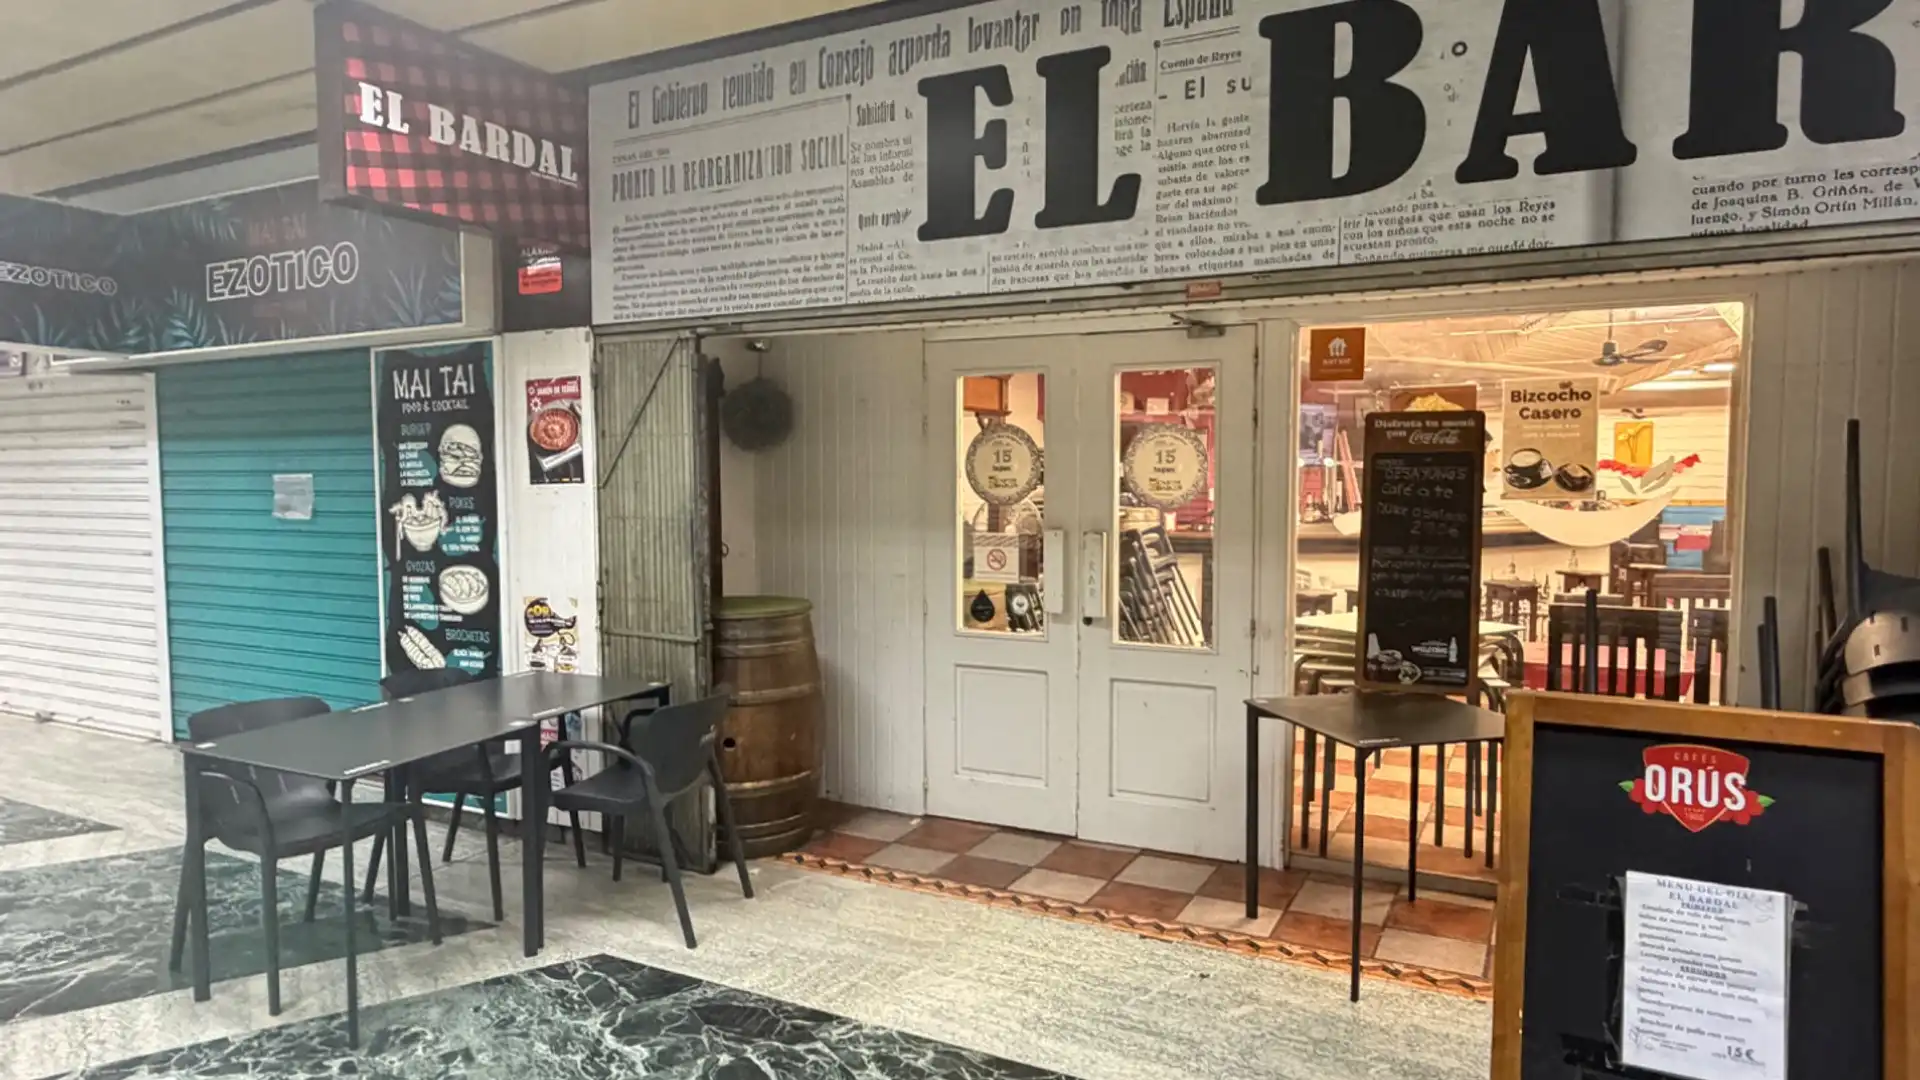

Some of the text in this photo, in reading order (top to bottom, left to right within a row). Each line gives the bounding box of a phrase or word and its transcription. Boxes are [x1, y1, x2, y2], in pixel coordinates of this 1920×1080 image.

[1197, 53, 1209, 65] de
[628, 90, 640, 129] El
[652, 81, 708, 125] Gobierno
[722, 62, 774, 111] reunido
[789, 58, 806, 96] en
[818, 39, 875, 91] Consejo
[1184, 75, 1205, 100] El
[358, 81, 578, 182] EL BARDAL
[917, 44, 1142, 241] EL
[612, 167, 656, 202] PRONTO
[662, 164, 676, 195] LA
[801, 133, 847, 171] SOCIAL
[1195, 171, 1208, 181] de
[1691, 180, 1745, 196] cuando
[1751, 177, 1778, 192] por
[1784, 173, 1827, 187] turno
[1834, 168, 1855, 180] les
[1174, 195, 1233, 209] del máximo
[1691, 199, 1709, 211] de
[1712, 190, 1778, 210] Joaquina
[1883, 179, 1903, 193] de
[1428, 210, 1452, 223] que
[1457, 207, 1486, 220] usan
[1493, 204, 1512, 215] los
[1518, 200, 1556, 214] Reyes
[1747, 209, 1758, 222] y
[1761, 203, 1811, 220] Simón
[1814, 199, 1857, 215] Ortín
[1343, 229, 1364, 241] con
[1367, 228, 1384, 240] los
[1421, 223, 1445, 236] que
[1477, 215, 1516, 229] noche
[1520, 214, 1538, 225] no
[1541, 213, 1555, 223] se
[1154, 240, 1173, 251] que
[1322, 249, 1336, 260] de
[1394, 236, 1439, 250] pronto.
[205, 241, 360, 302] EZOTICO
[393, 362, 476, 400] MAI TAI
[1510, 387, 1592, 403] Bizcocho
[1374, 418, 1423, 429] Disfruta
[1518, 406, 1582, 420] Casero
[992, 448, 1013, 464] 15
[1155, 448, 1177, 465] 15
[1644, 763, 1747, 812] ORÚS
[1688, 895, 1739, 910] BARDAL
